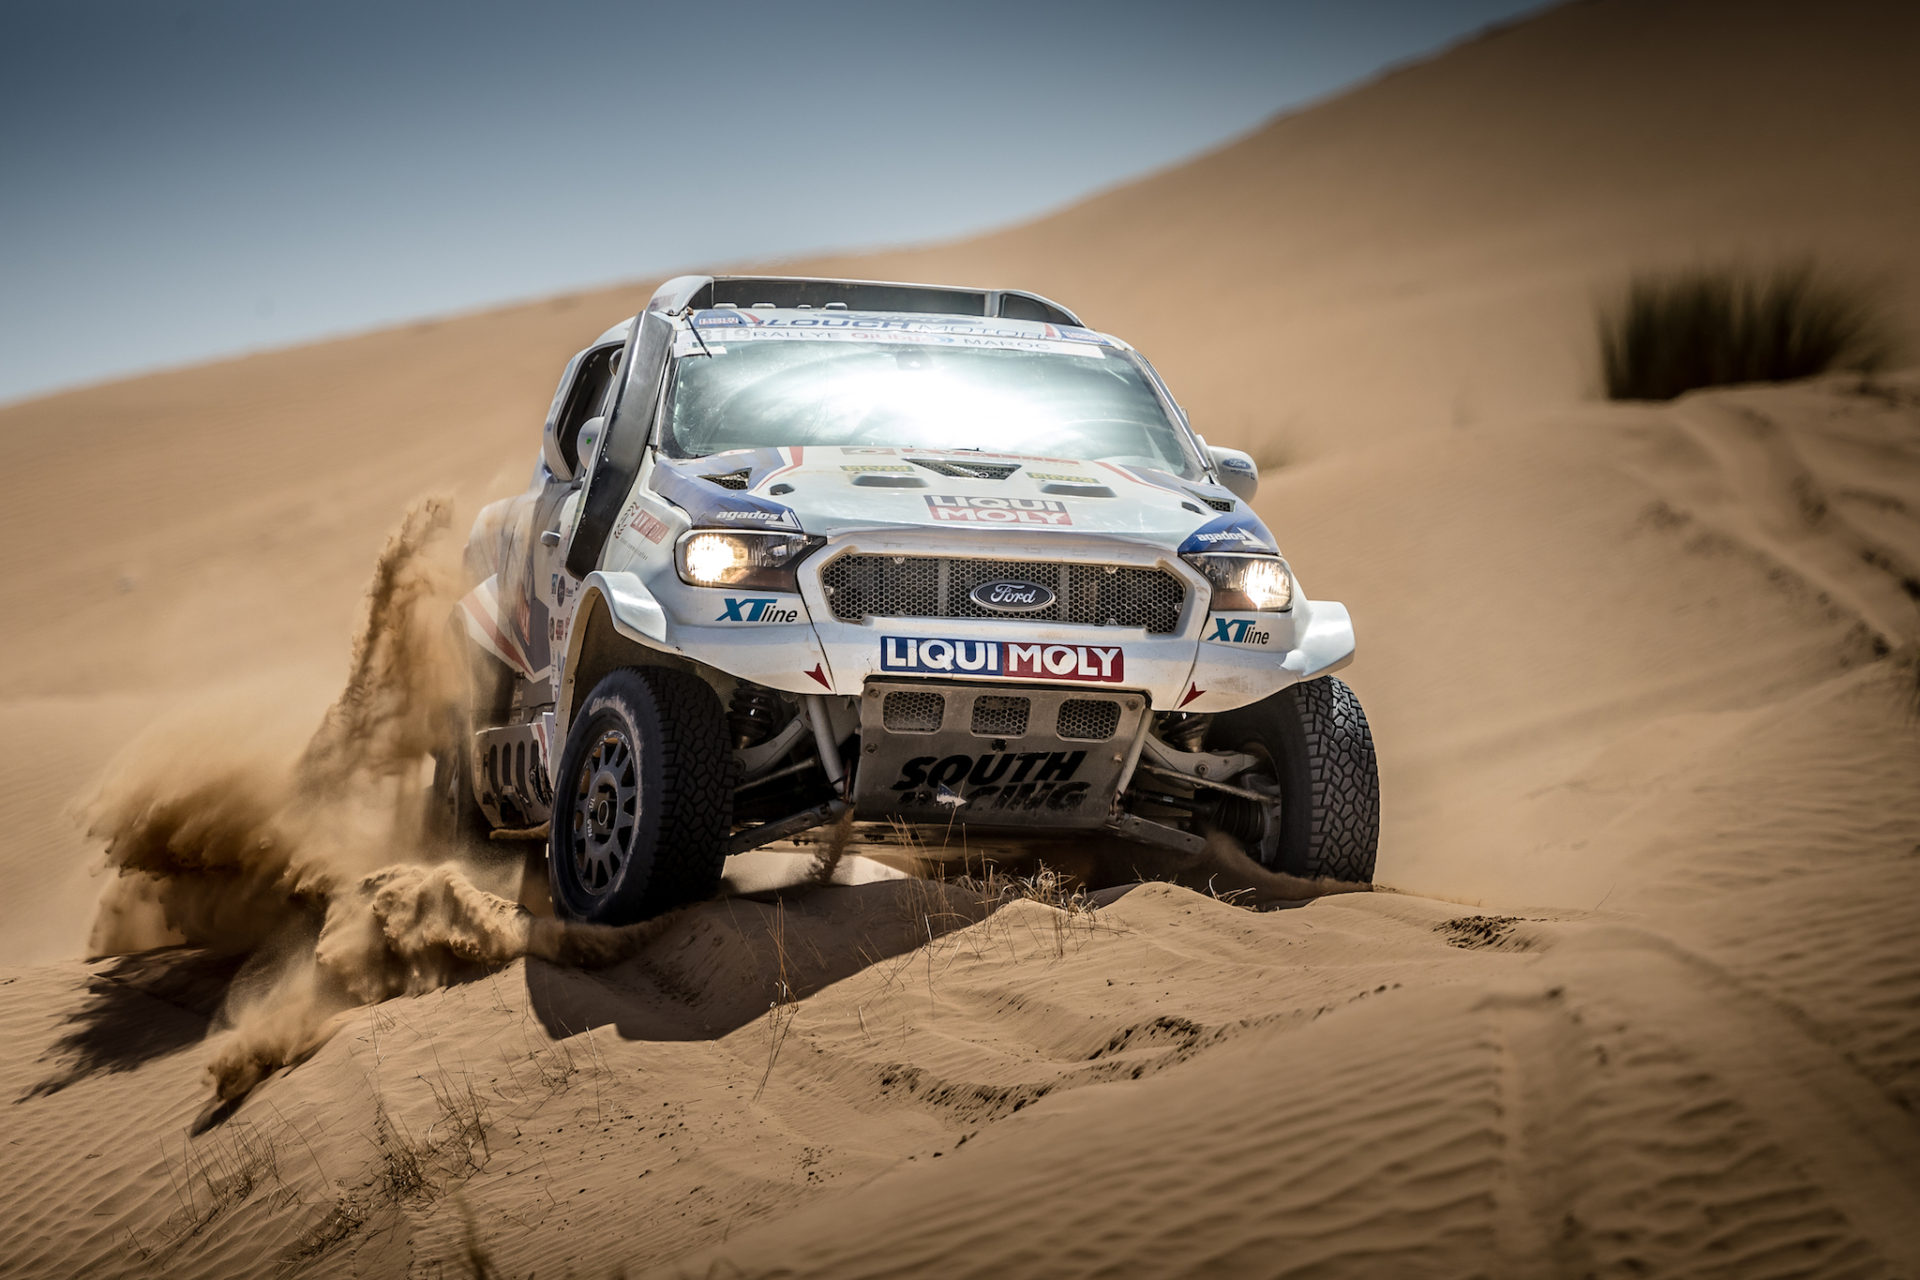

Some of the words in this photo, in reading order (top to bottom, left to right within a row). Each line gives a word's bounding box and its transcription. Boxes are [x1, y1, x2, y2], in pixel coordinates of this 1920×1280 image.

[753, 331, 841, 339] RALLYE
[963, 338, 1051, 350] MAROC
[930, 495, 1062, 513] LIQUI
[716, 510, 781, 521] agados
[938, 508, 1070, 525] MOLY
[1196, 531, 1247, 543] agados
[990, 583, 1036, 604] Ford
[714, 598, 798, 623] XTline
[1207, 618, 1270, 645] XTline
[886, 638, 998, 671] LIQUI
[1008, 643, 1121, 677] MOLY
[889, 750, 1088, 791] SOUTH
